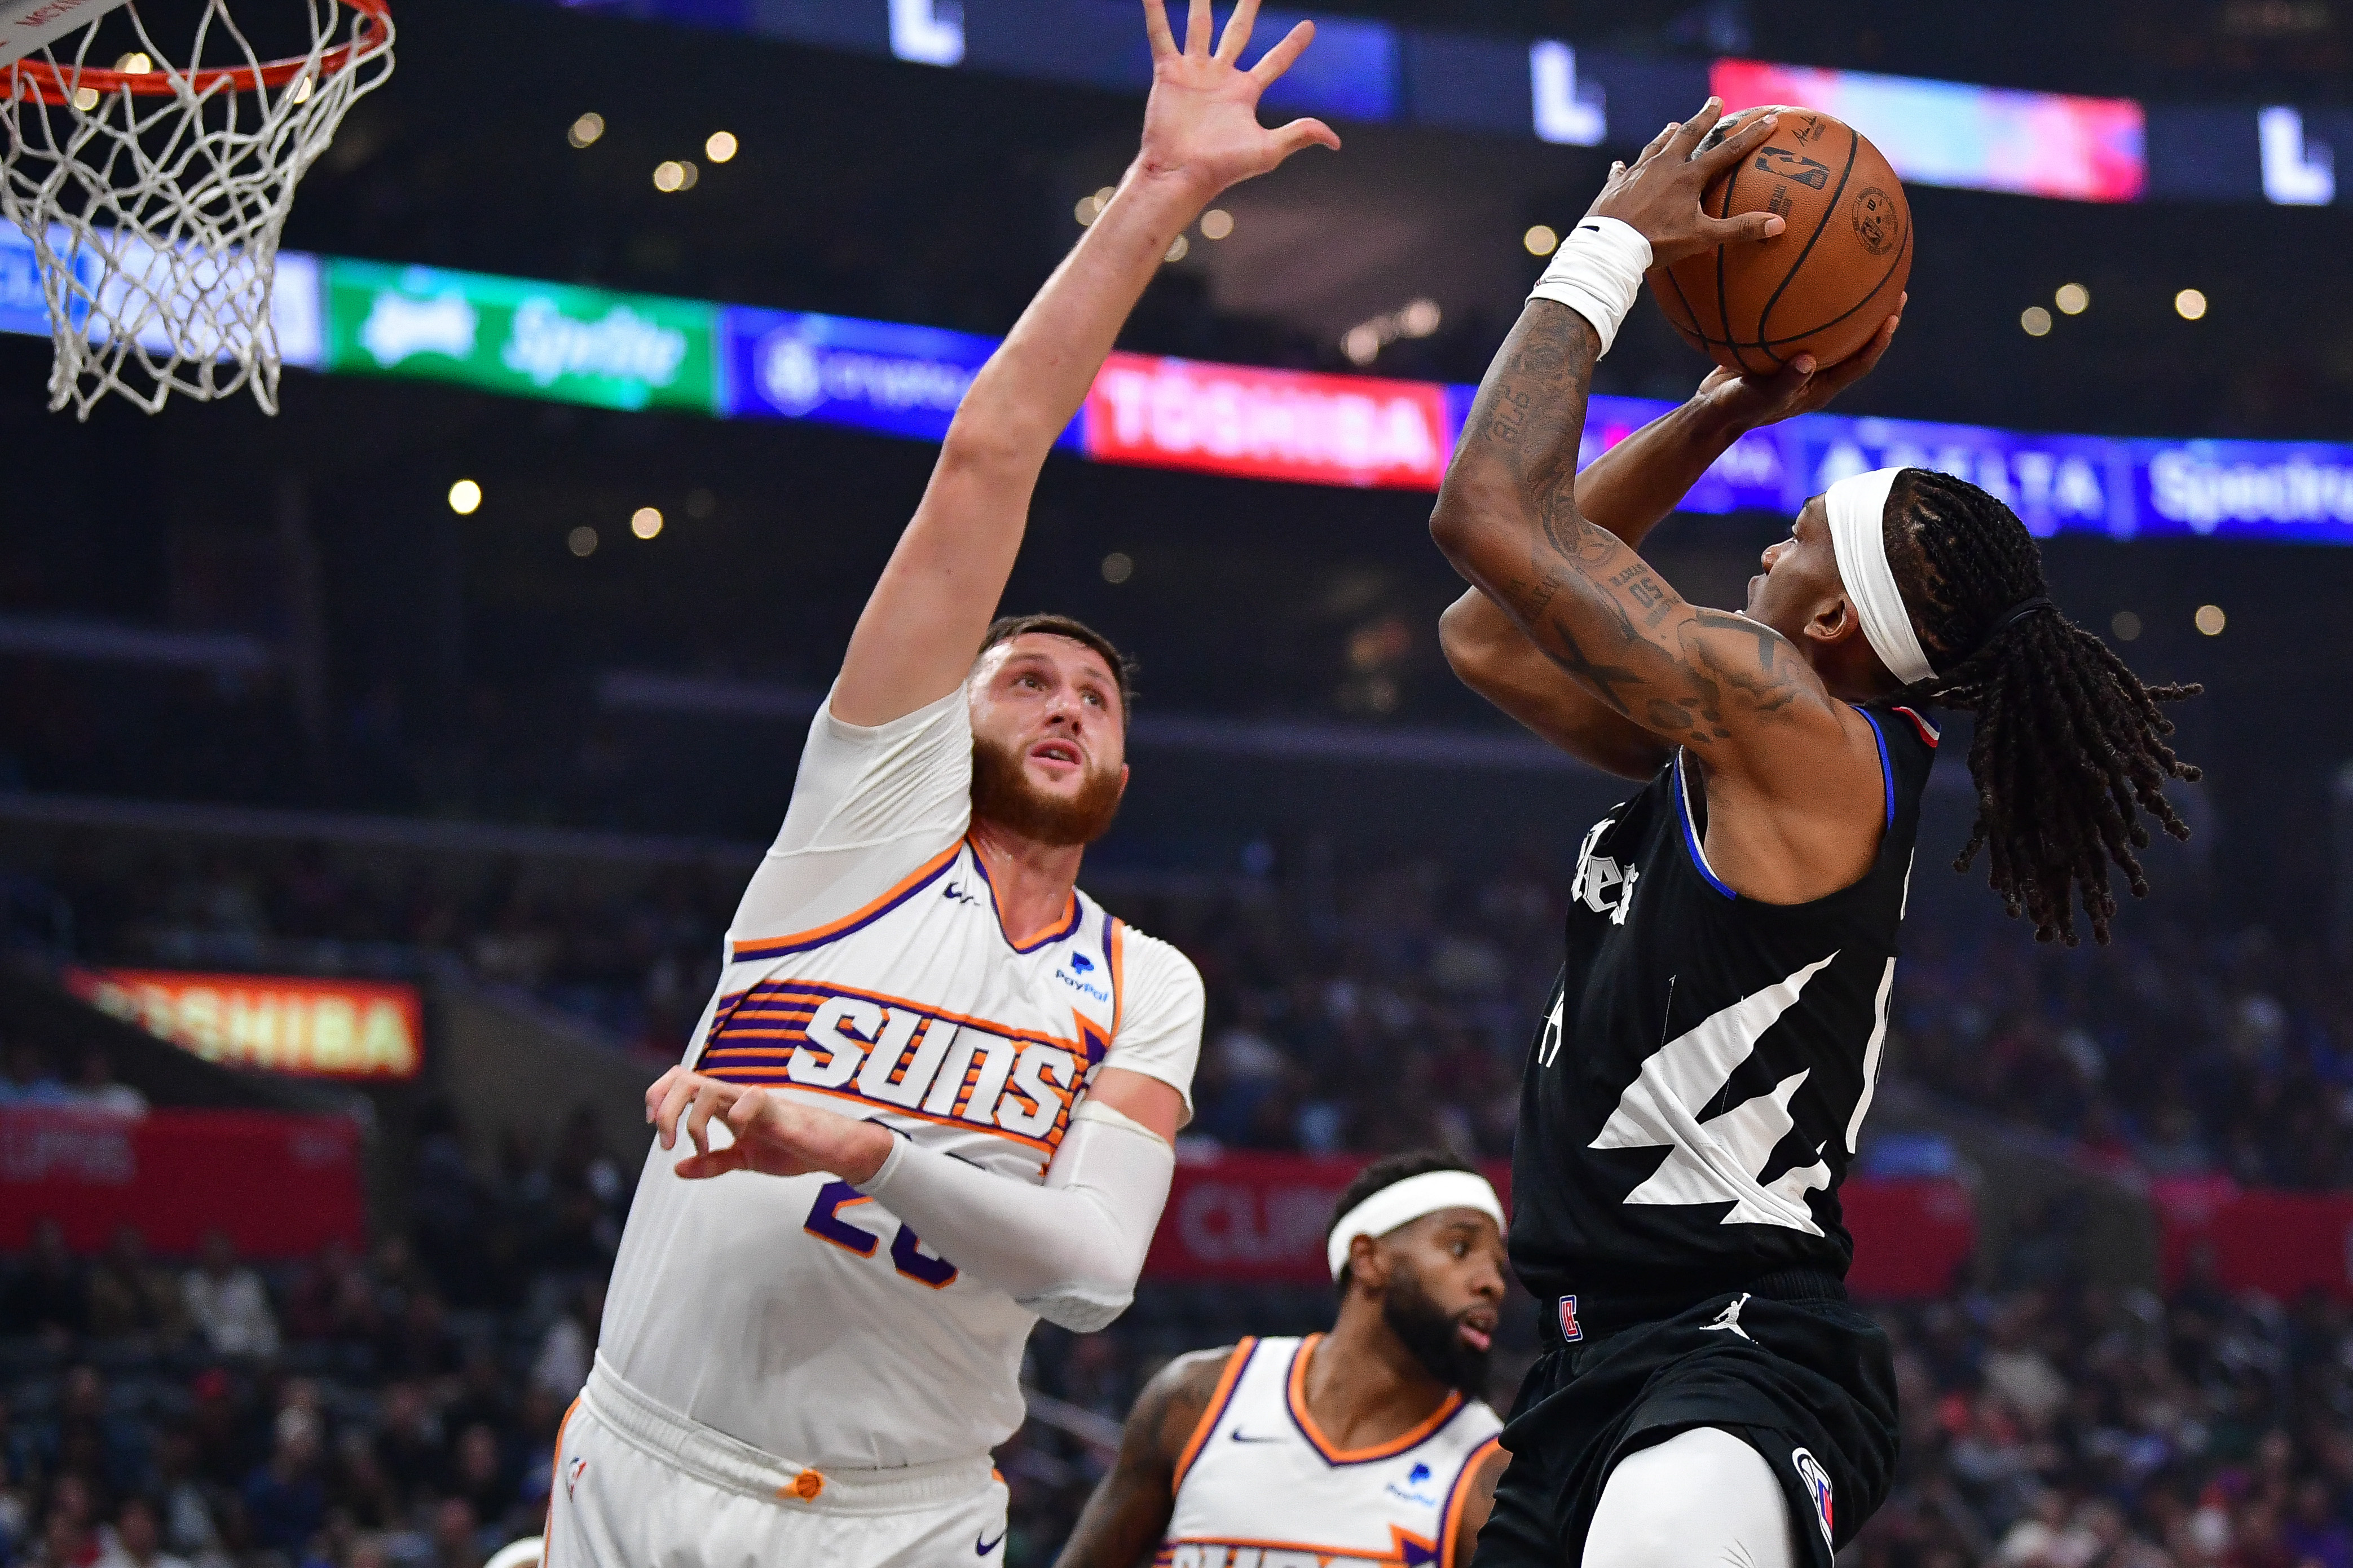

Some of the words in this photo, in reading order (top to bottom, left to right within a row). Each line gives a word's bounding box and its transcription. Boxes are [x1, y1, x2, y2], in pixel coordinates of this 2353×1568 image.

[1097, 366, 1436, 472] TOSHIBA
[1055, 968, 1109, 1003] PayPal
[788, 995, 1076, 1139] SUNS
